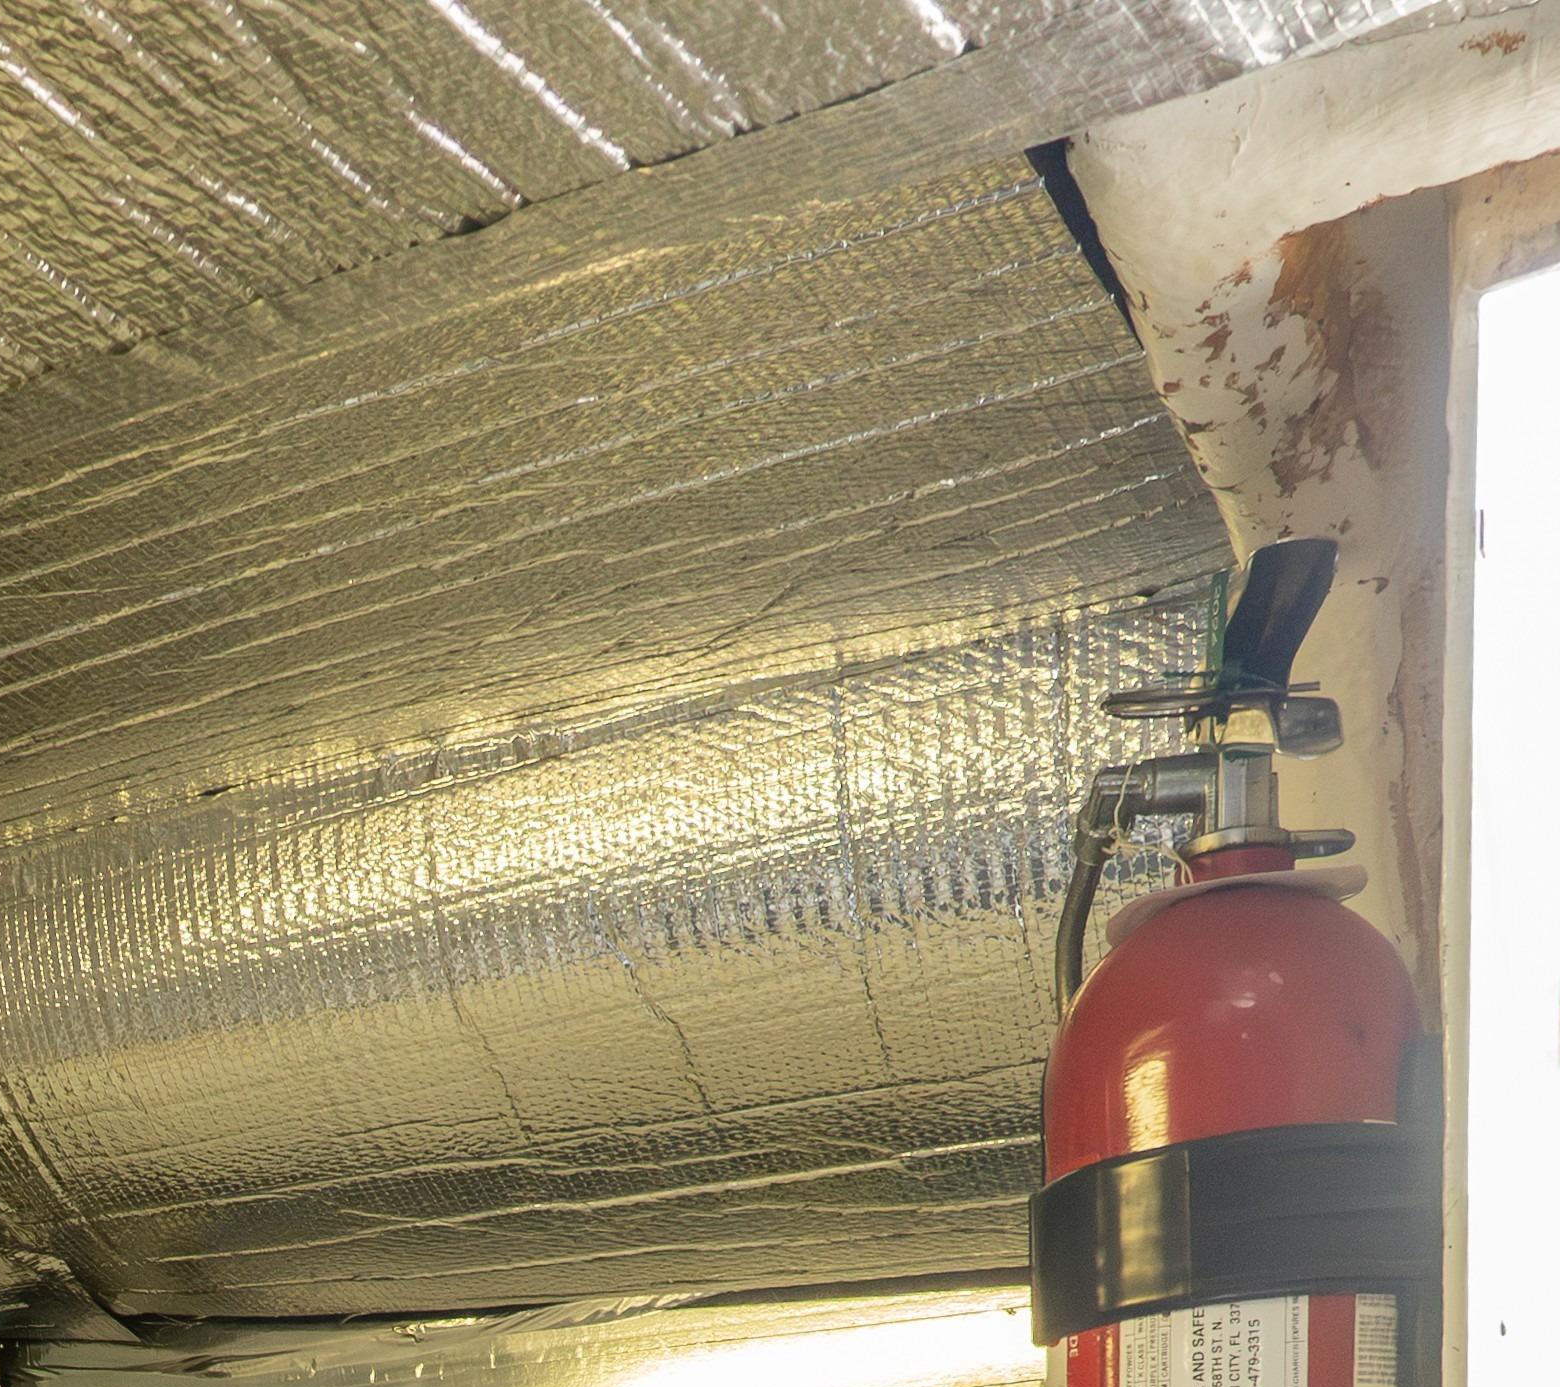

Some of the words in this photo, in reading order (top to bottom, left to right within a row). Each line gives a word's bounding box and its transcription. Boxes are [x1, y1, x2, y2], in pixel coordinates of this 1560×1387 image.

[1230, 1331, 1240, 1345] FL
[1192, 1352, 1205, 1382] AND
[1212, 1356, 1223, 1387] 58TH
